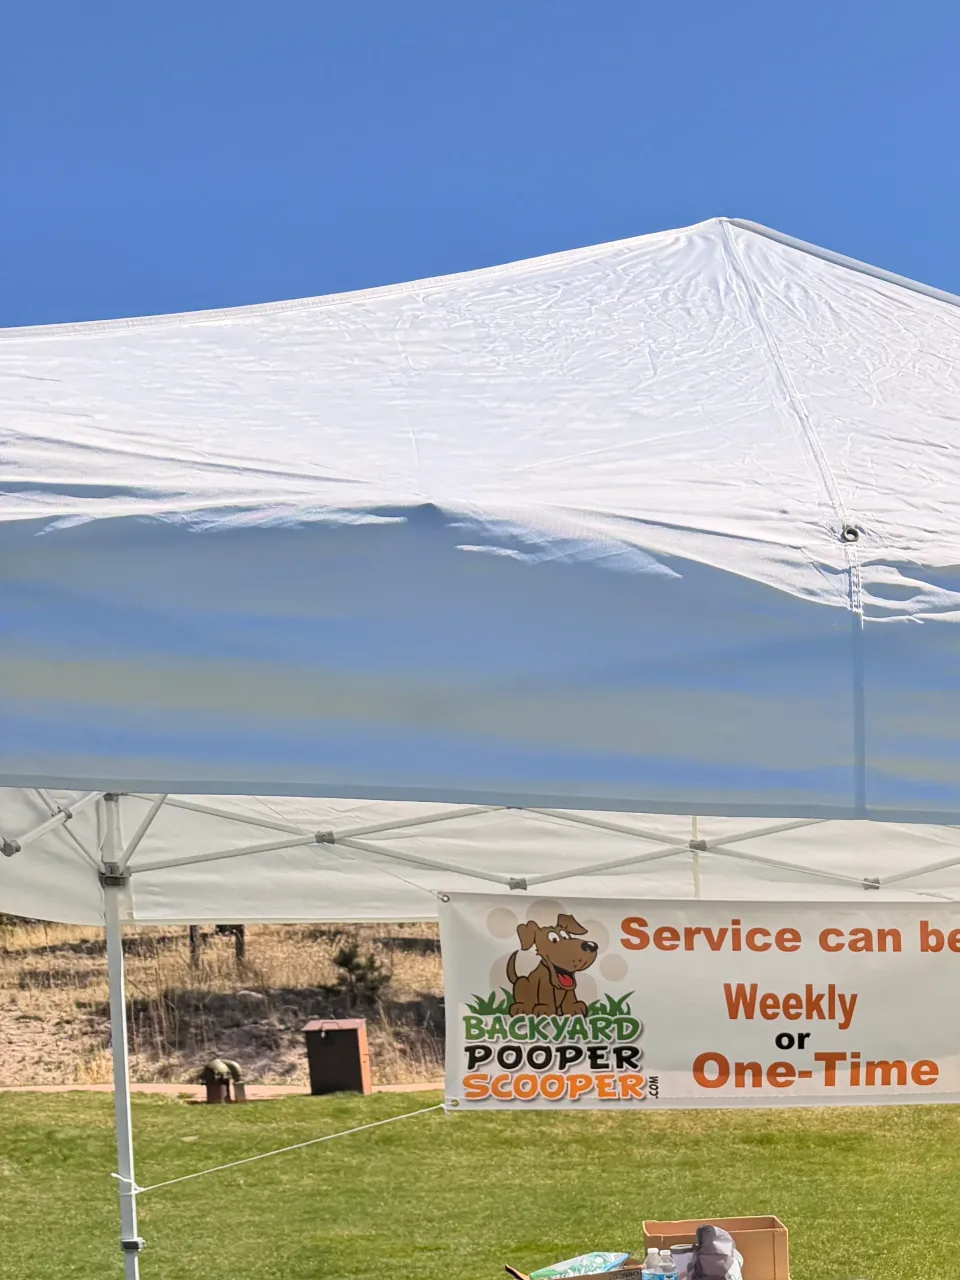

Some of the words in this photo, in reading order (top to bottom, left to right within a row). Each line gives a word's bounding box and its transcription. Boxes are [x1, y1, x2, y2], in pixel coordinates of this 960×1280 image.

[620, 916, 802, 951] Service
[818, 927, 902, 953] can
[723, 983, 858, 1030] Weekly
[462, 1015, 641, 1042] BACKYARD
[775, 1031, 811, 1050] or
[464, 1045, 641, 1070] POOPER
[692, 1051, 939, 1088] One-Time
[462, 1073, 645, 1099] SCOOPER
